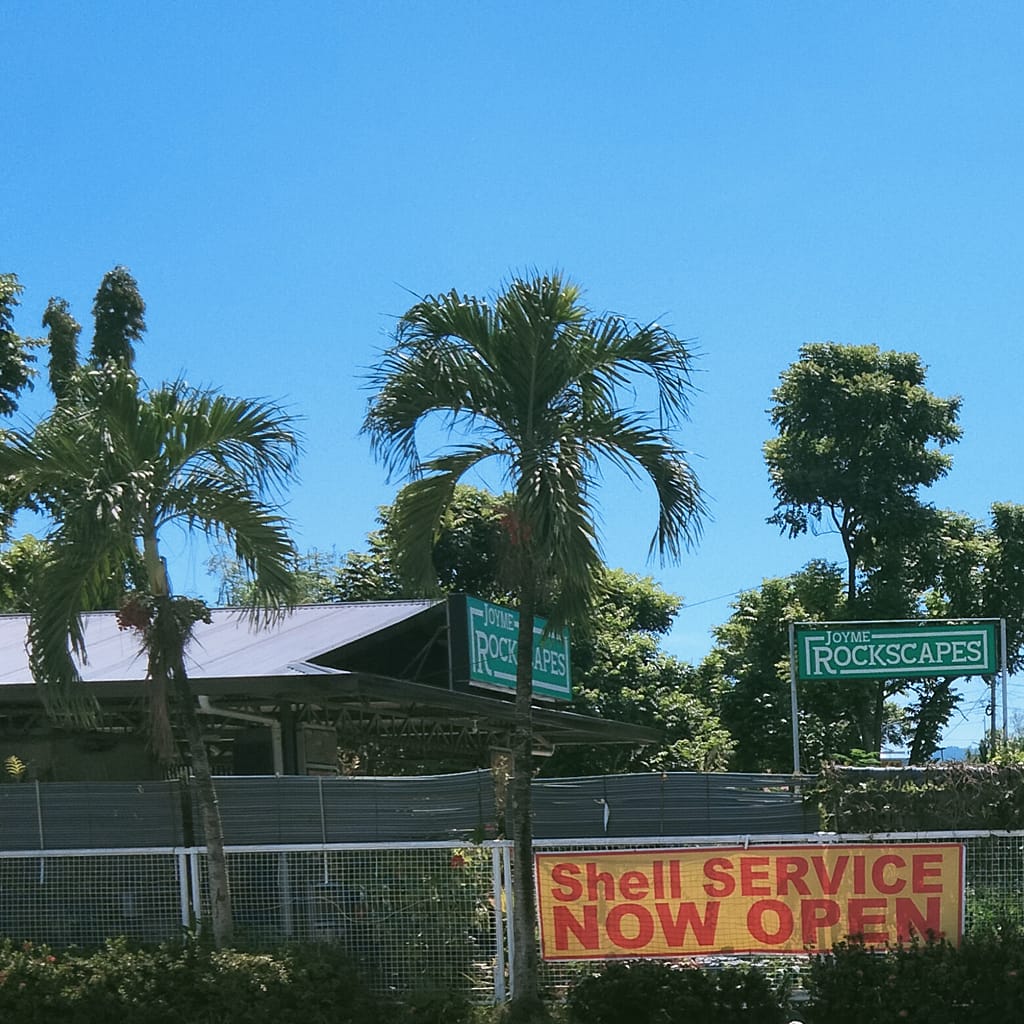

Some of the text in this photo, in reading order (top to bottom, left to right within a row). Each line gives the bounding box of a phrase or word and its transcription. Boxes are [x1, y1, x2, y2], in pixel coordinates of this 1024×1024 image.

[484, 603, 514, 631] JOYME
[475, 630, 566, 676] ROCKAPES
[813, 640, 982, 675] ROCKSCAPES
[825, 631, 871, 646] JOYME
[551, 853, 943, 902] Shell SERVICE
[553, 896, 942, 951] NOW OPEN
